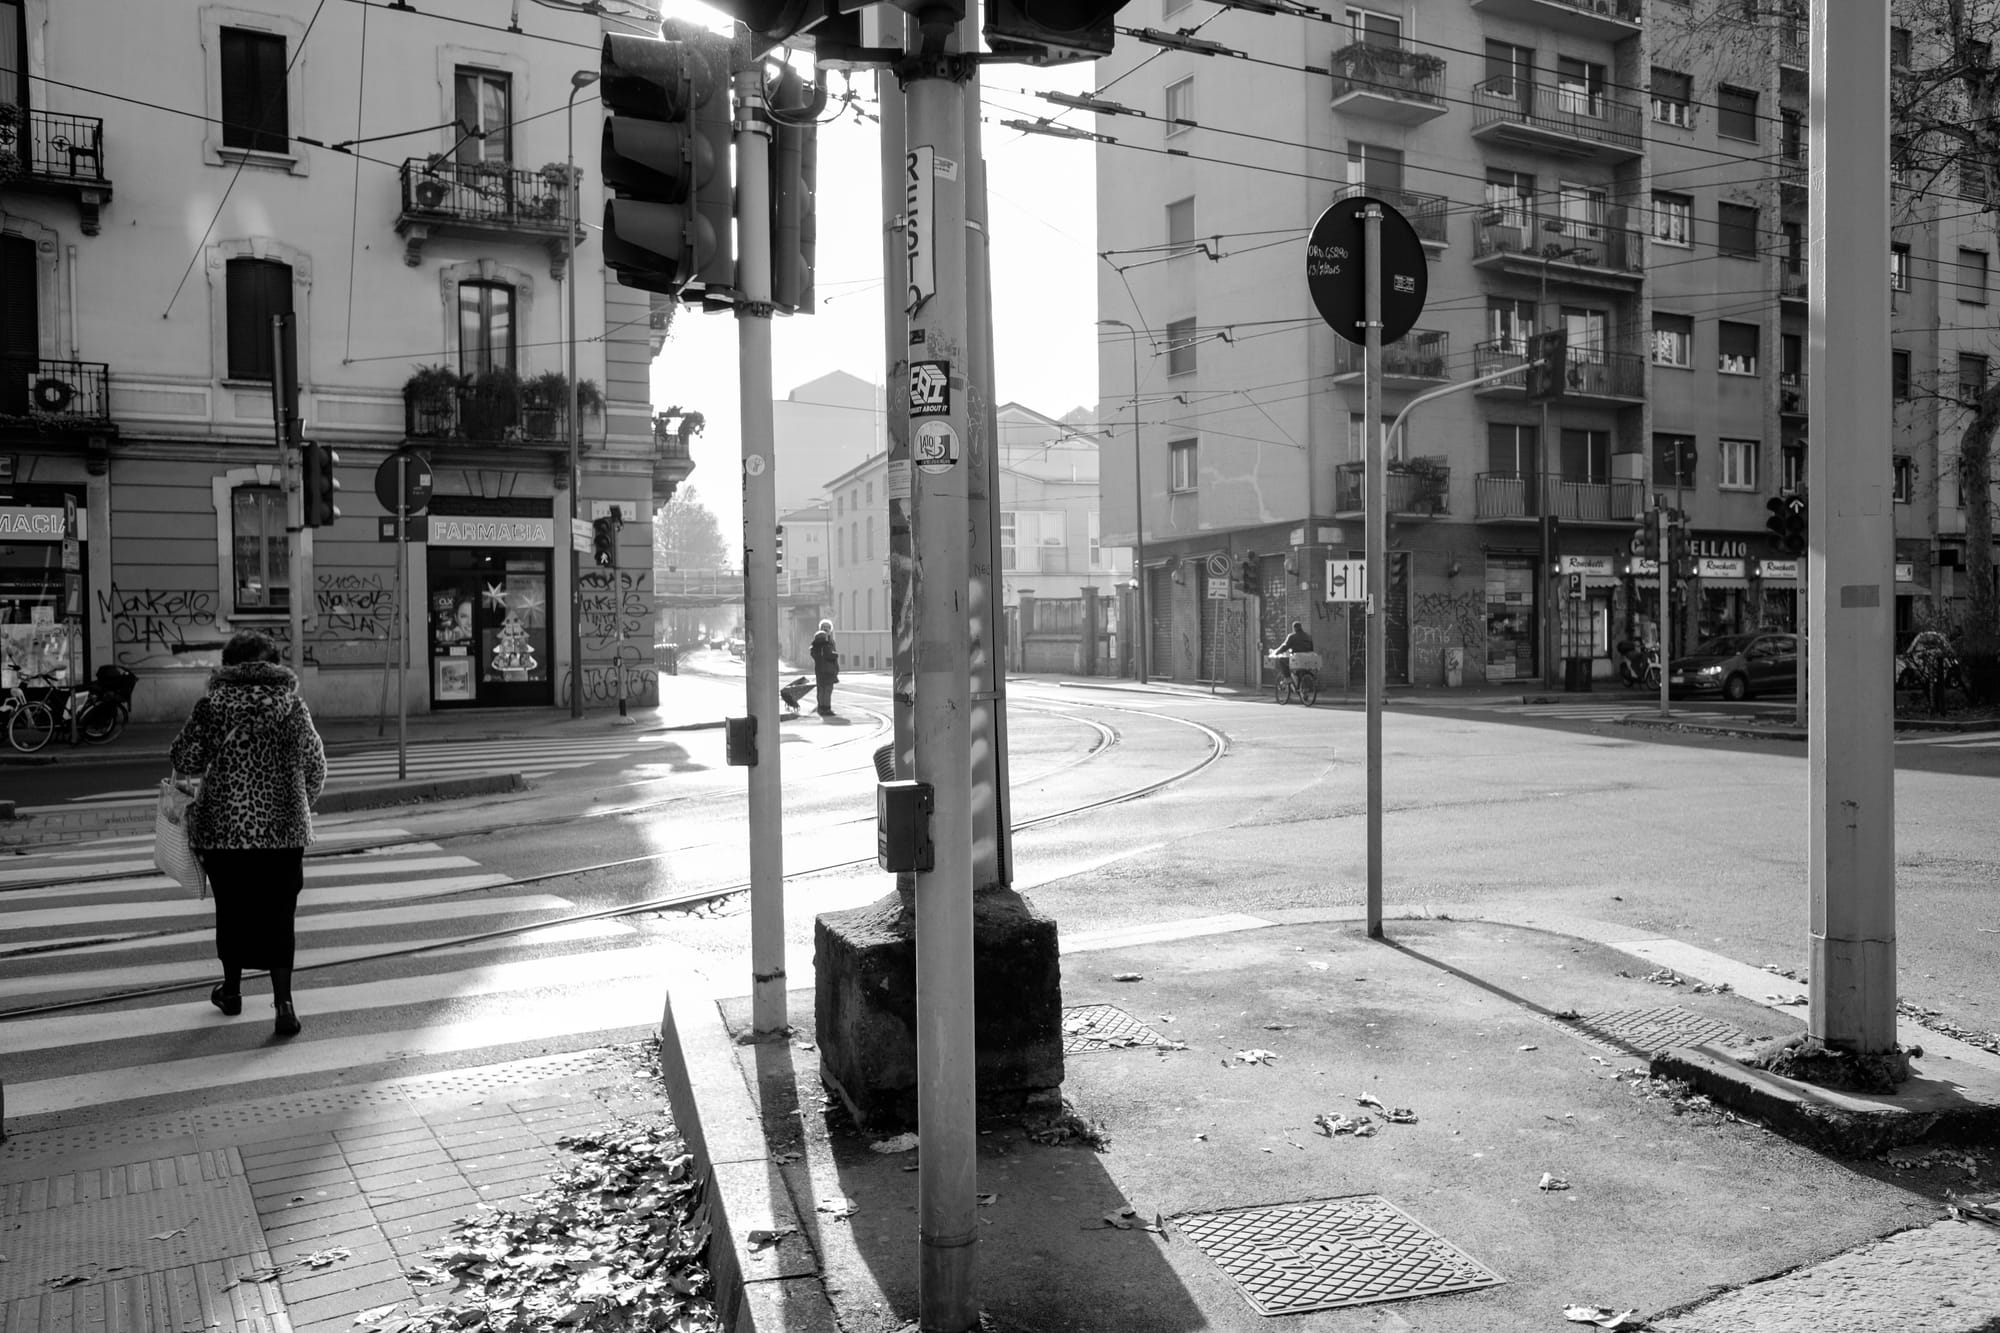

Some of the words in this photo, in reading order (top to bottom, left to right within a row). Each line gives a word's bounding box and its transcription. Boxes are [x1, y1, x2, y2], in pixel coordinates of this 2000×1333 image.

[922, 405, 941, 413] ABOUT
[941, 404, 948, 412] IT
[67, 501, 75, 534] P
[434, 522, 546, 542] FARMACIA
[1571, 575, 1579, 588] P
